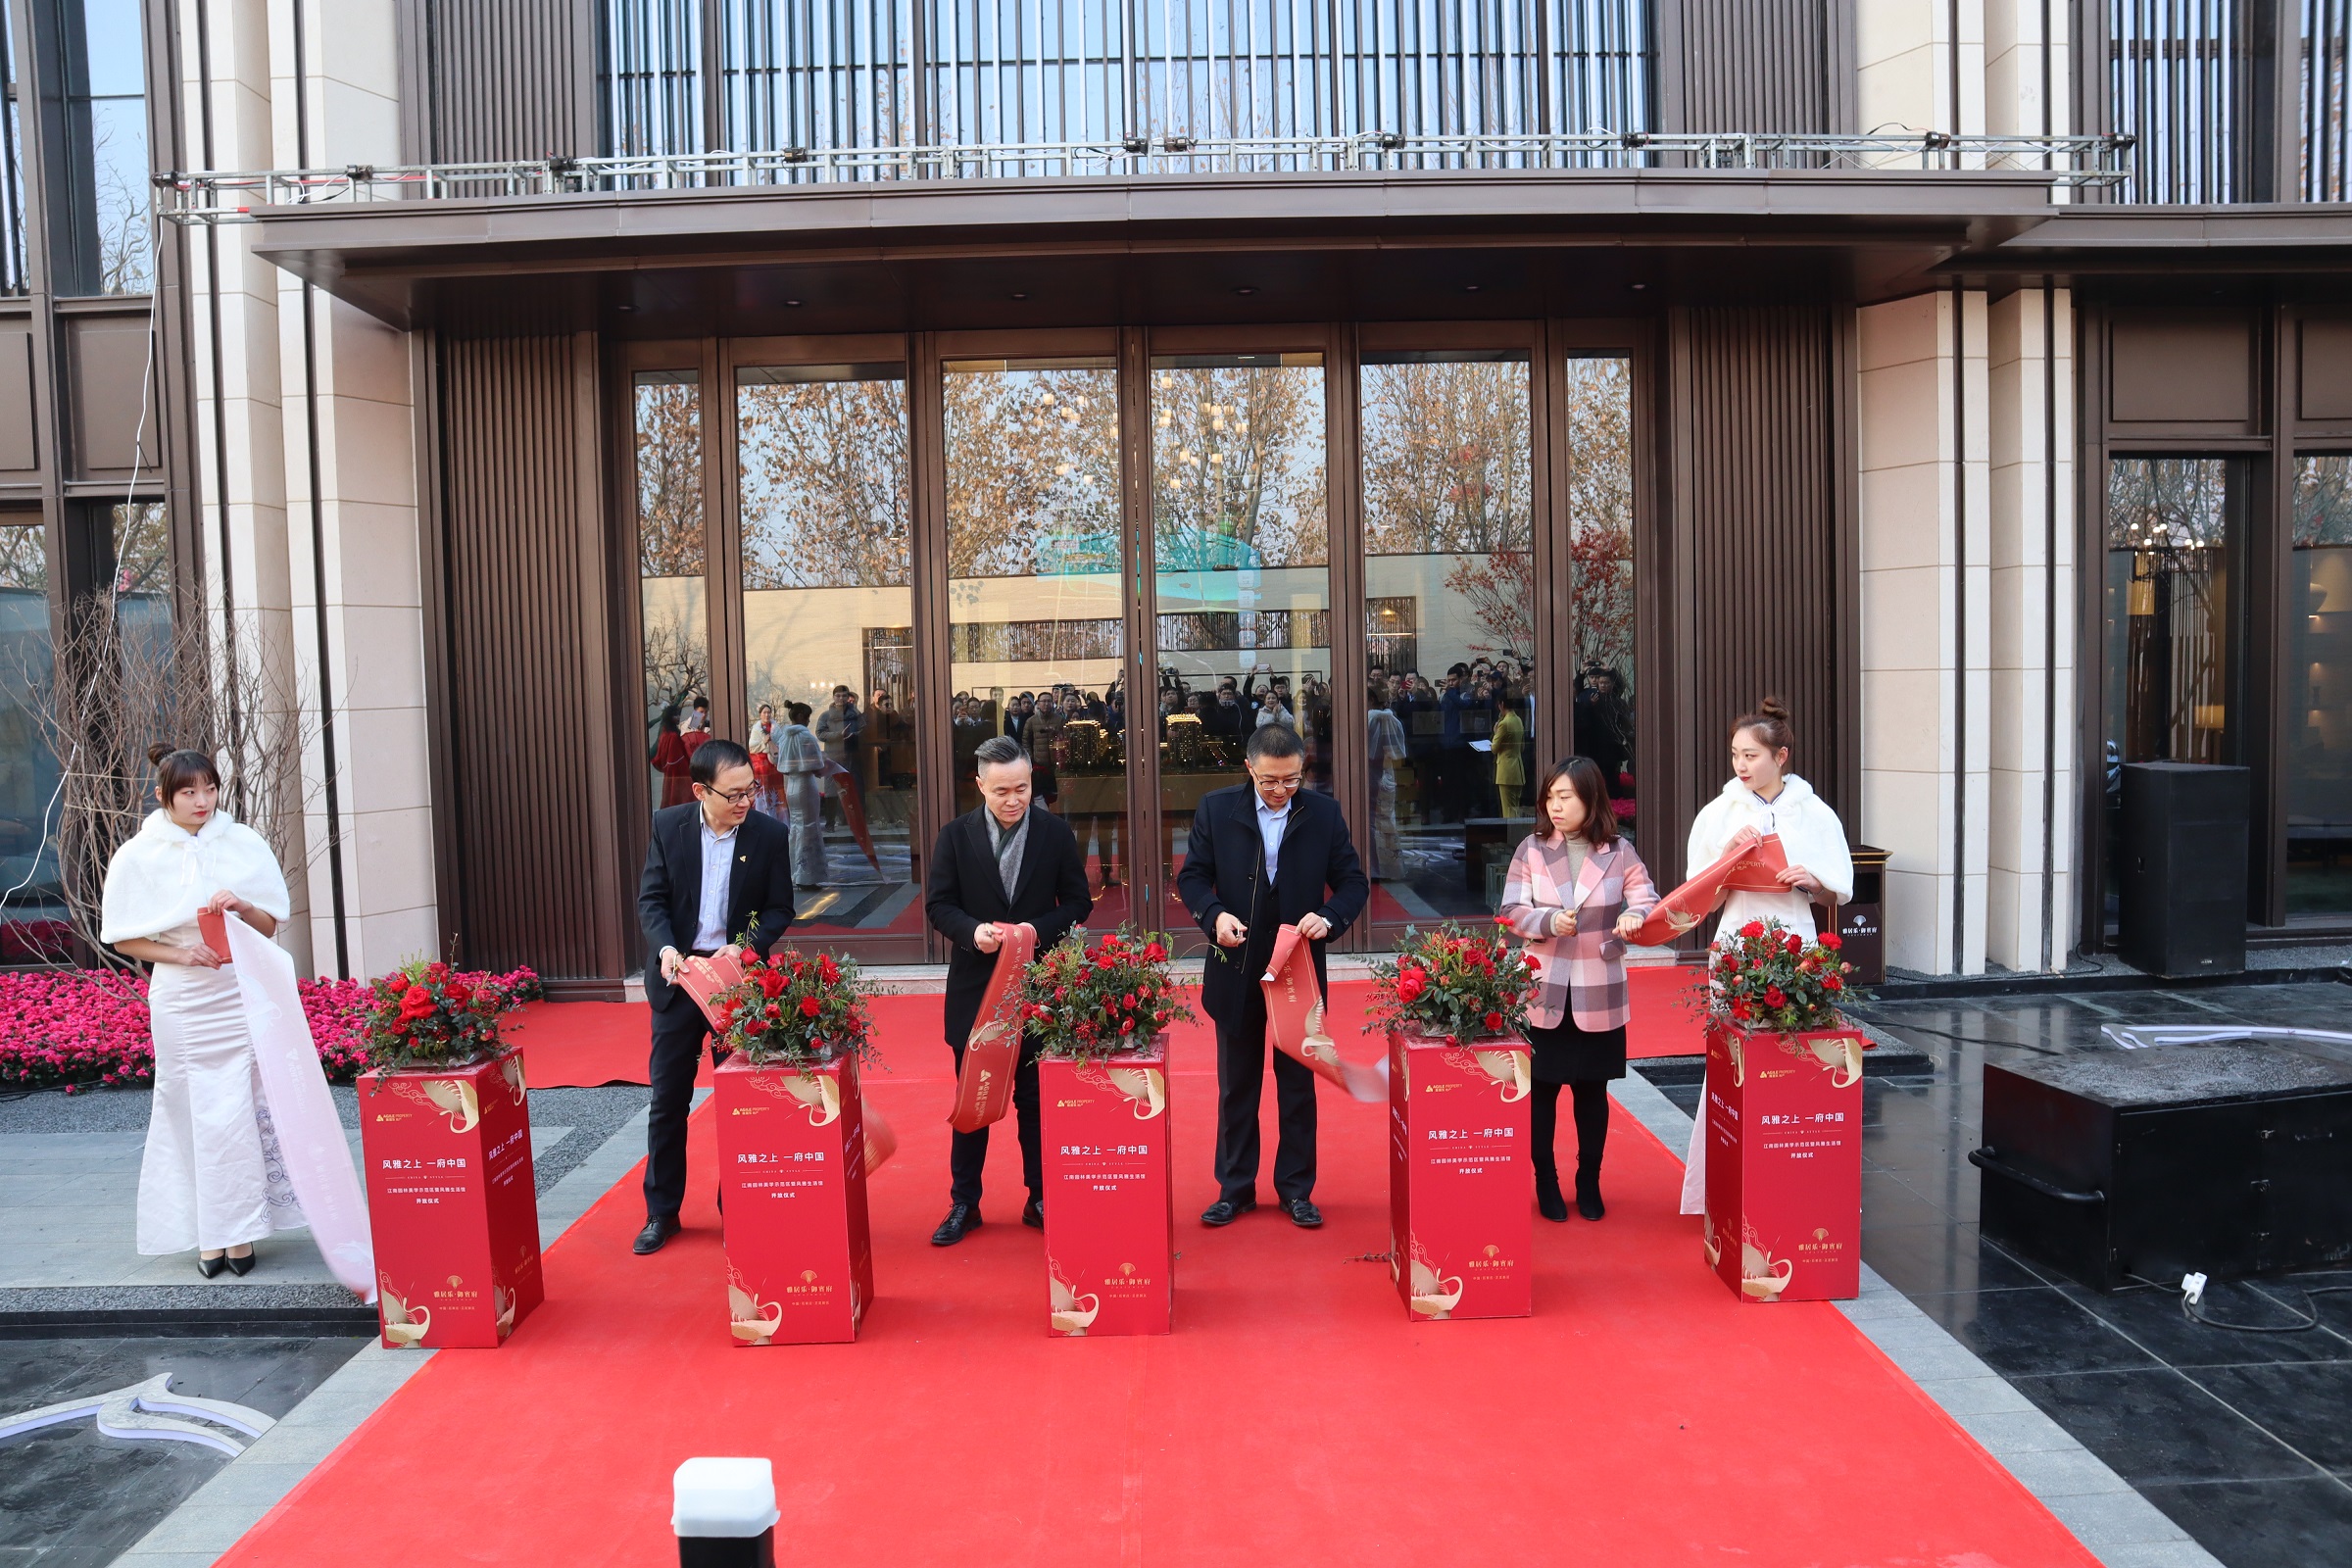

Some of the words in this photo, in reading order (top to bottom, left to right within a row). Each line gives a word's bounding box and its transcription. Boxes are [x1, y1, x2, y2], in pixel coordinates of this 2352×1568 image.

[1761, 1113, 1800, 1125] 风雅之上
[1804, 1111, 1844, 1123] 一府中国
[1428, 1128, 1469, 1141] 风雅之上
[1473, 1127, 1514, 1138] 一府中国
[1060, 1145, 1102, 1155] 风雅之上
[1105, 1145, 1148, 1155] 一府中国
[382, 1158, 422, 1170] 风雅之上
[426, 1157, 466, 1168] 一府中国
[737, 1152, 779, 1164] 风雅之上
[783, 1152, 825, 1162] 一府中国
